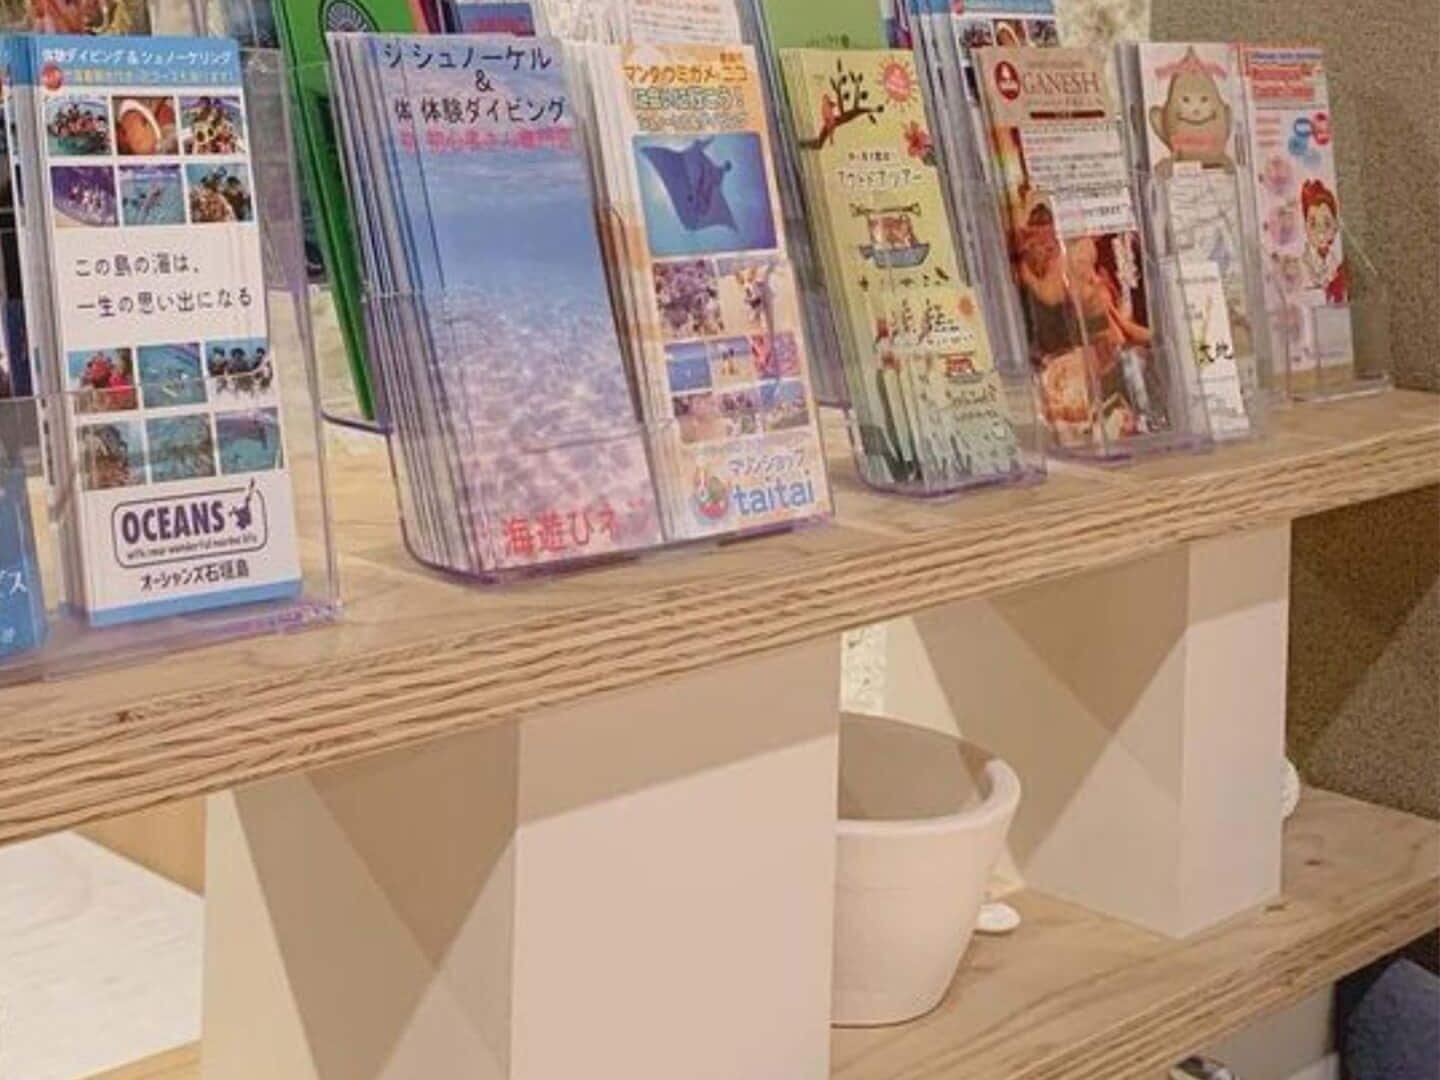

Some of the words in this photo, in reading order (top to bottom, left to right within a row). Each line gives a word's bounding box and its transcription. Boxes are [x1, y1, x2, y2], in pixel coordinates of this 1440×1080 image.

[413, 46, 552, 70] シュノーケル
[475, 71, 494, 92] &
[1023, 71, 1100, 96] GANESH
[422, 97, 566, 123] 体験ダイビング
[121, 500, 226, 544] OCEANS
